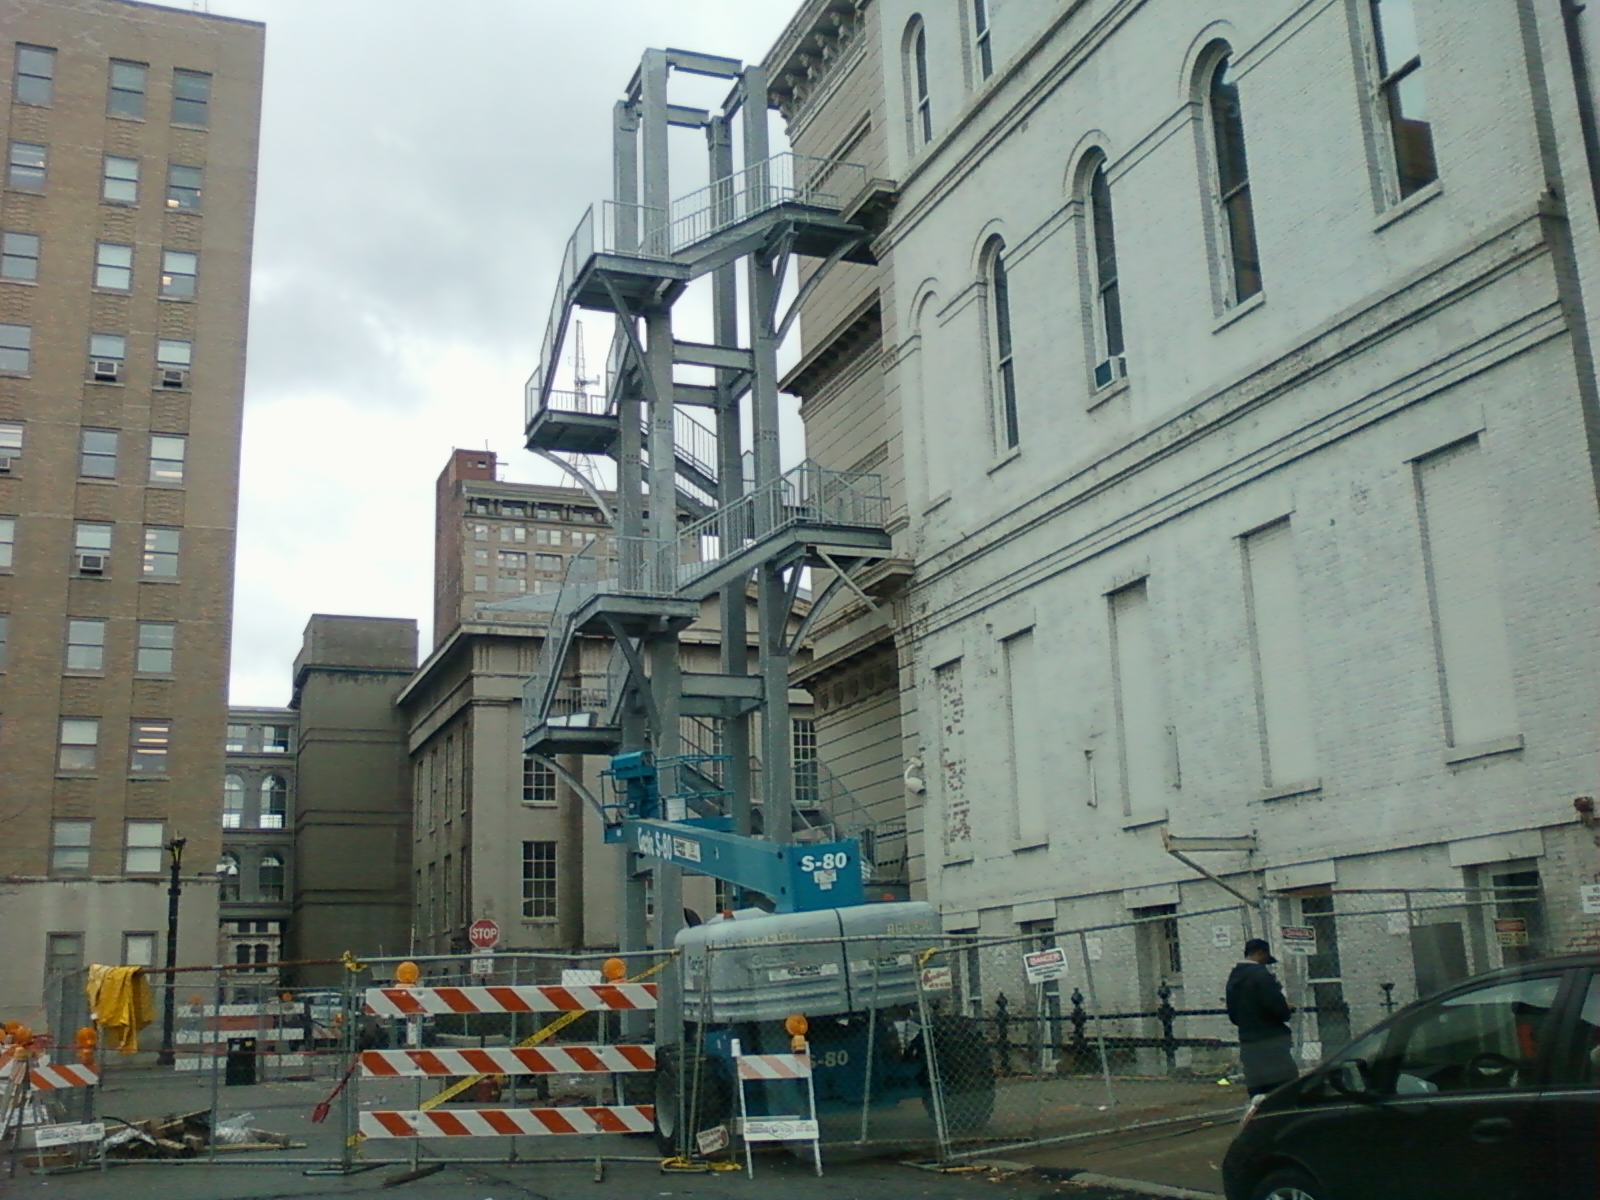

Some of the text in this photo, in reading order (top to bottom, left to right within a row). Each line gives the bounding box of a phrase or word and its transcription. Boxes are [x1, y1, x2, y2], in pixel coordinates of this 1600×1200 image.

[655, 831, 672, 861] S-80
[801, 852, 847, 872] S-80
[472, 928, 497, 939] STOP
